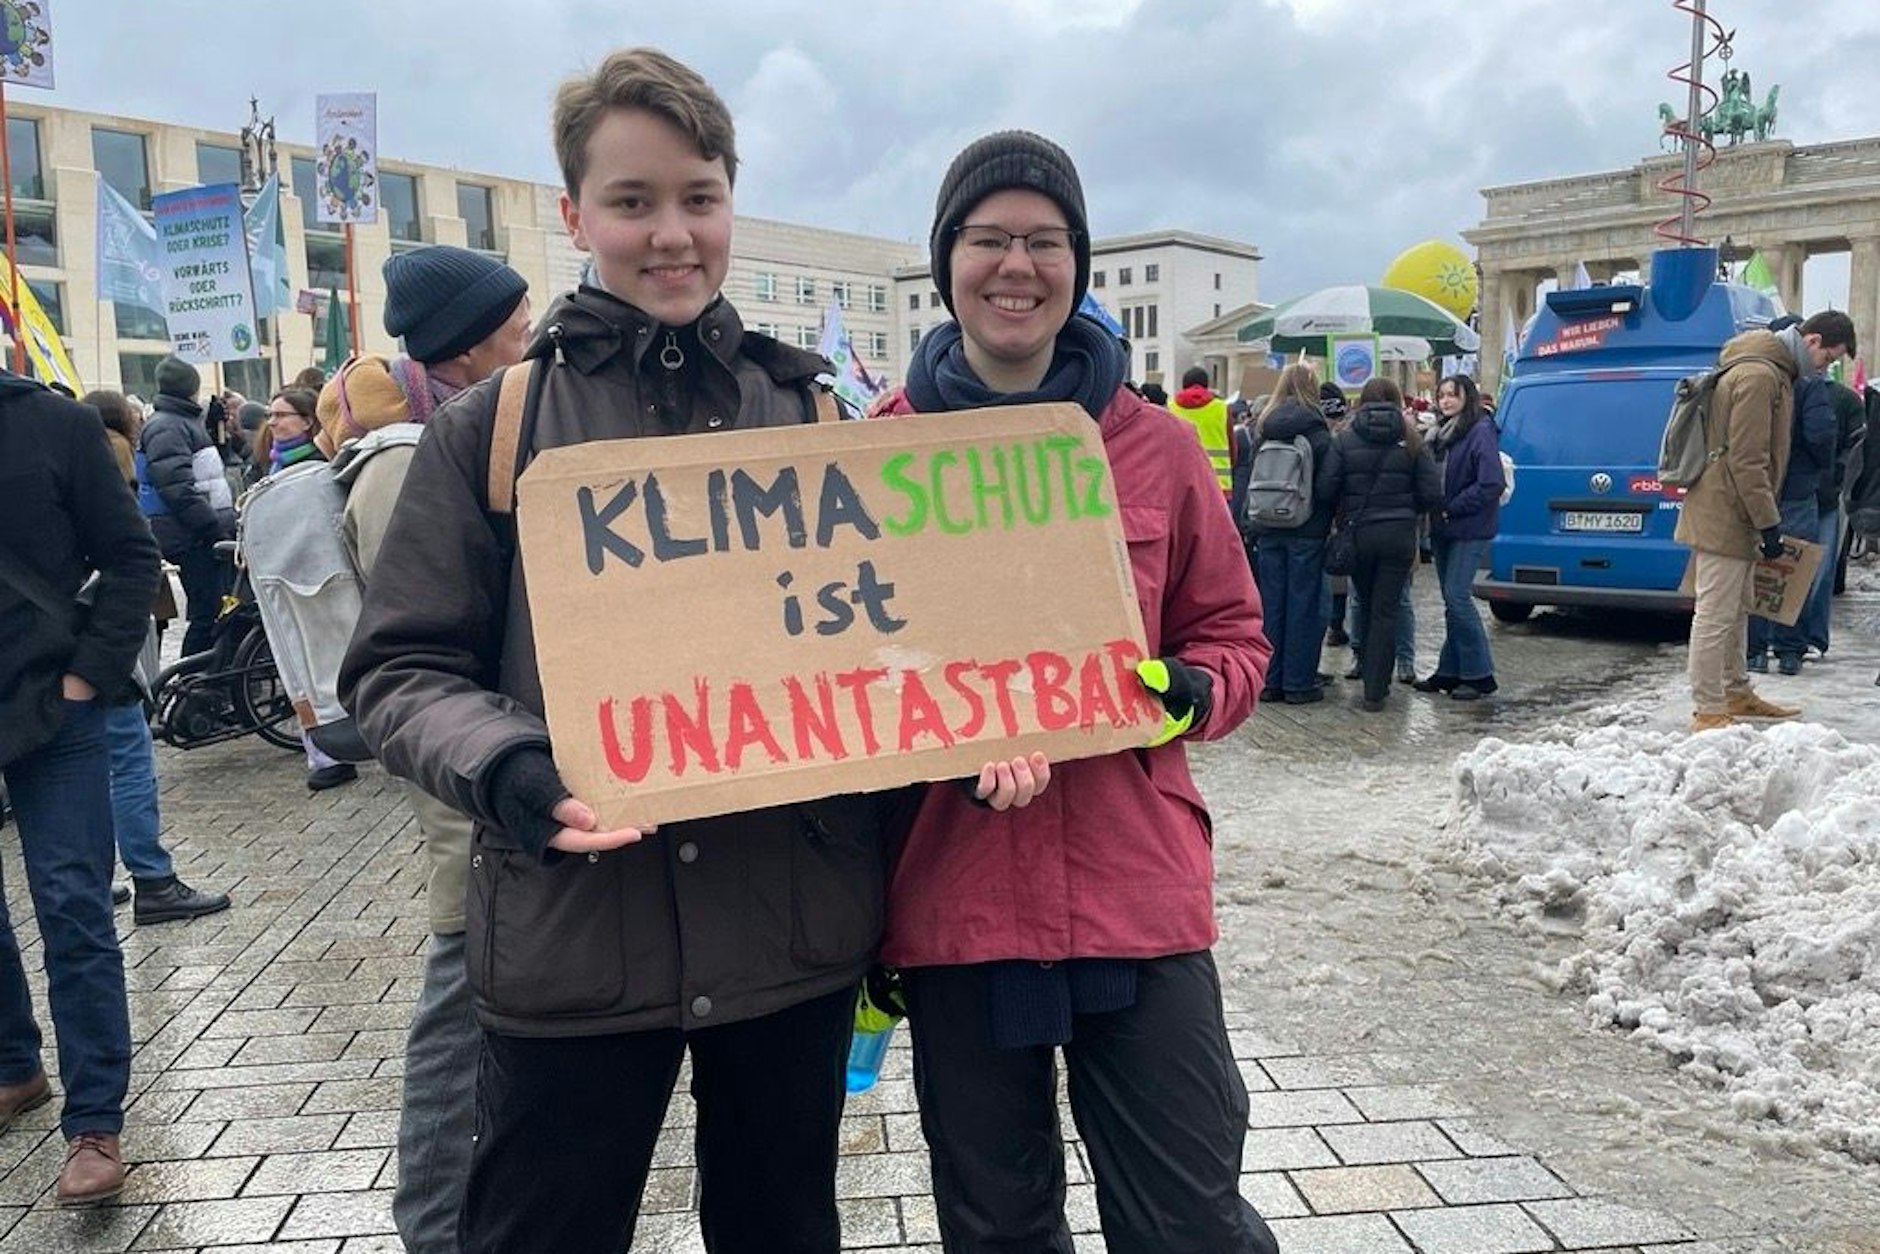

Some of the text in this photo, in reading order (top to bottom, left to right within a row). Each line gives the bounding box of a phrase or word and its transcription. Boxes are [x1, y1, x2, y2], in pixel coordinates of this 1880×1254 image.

[1562, 324, 1582, 338] WIR
[1538, 343, 1559, 357] DAS
[1631, 481, 1663, 492] rbb
[776, 560, 908, 636] ist
[599, 638, 1161, 783] UNANTASTBAR
